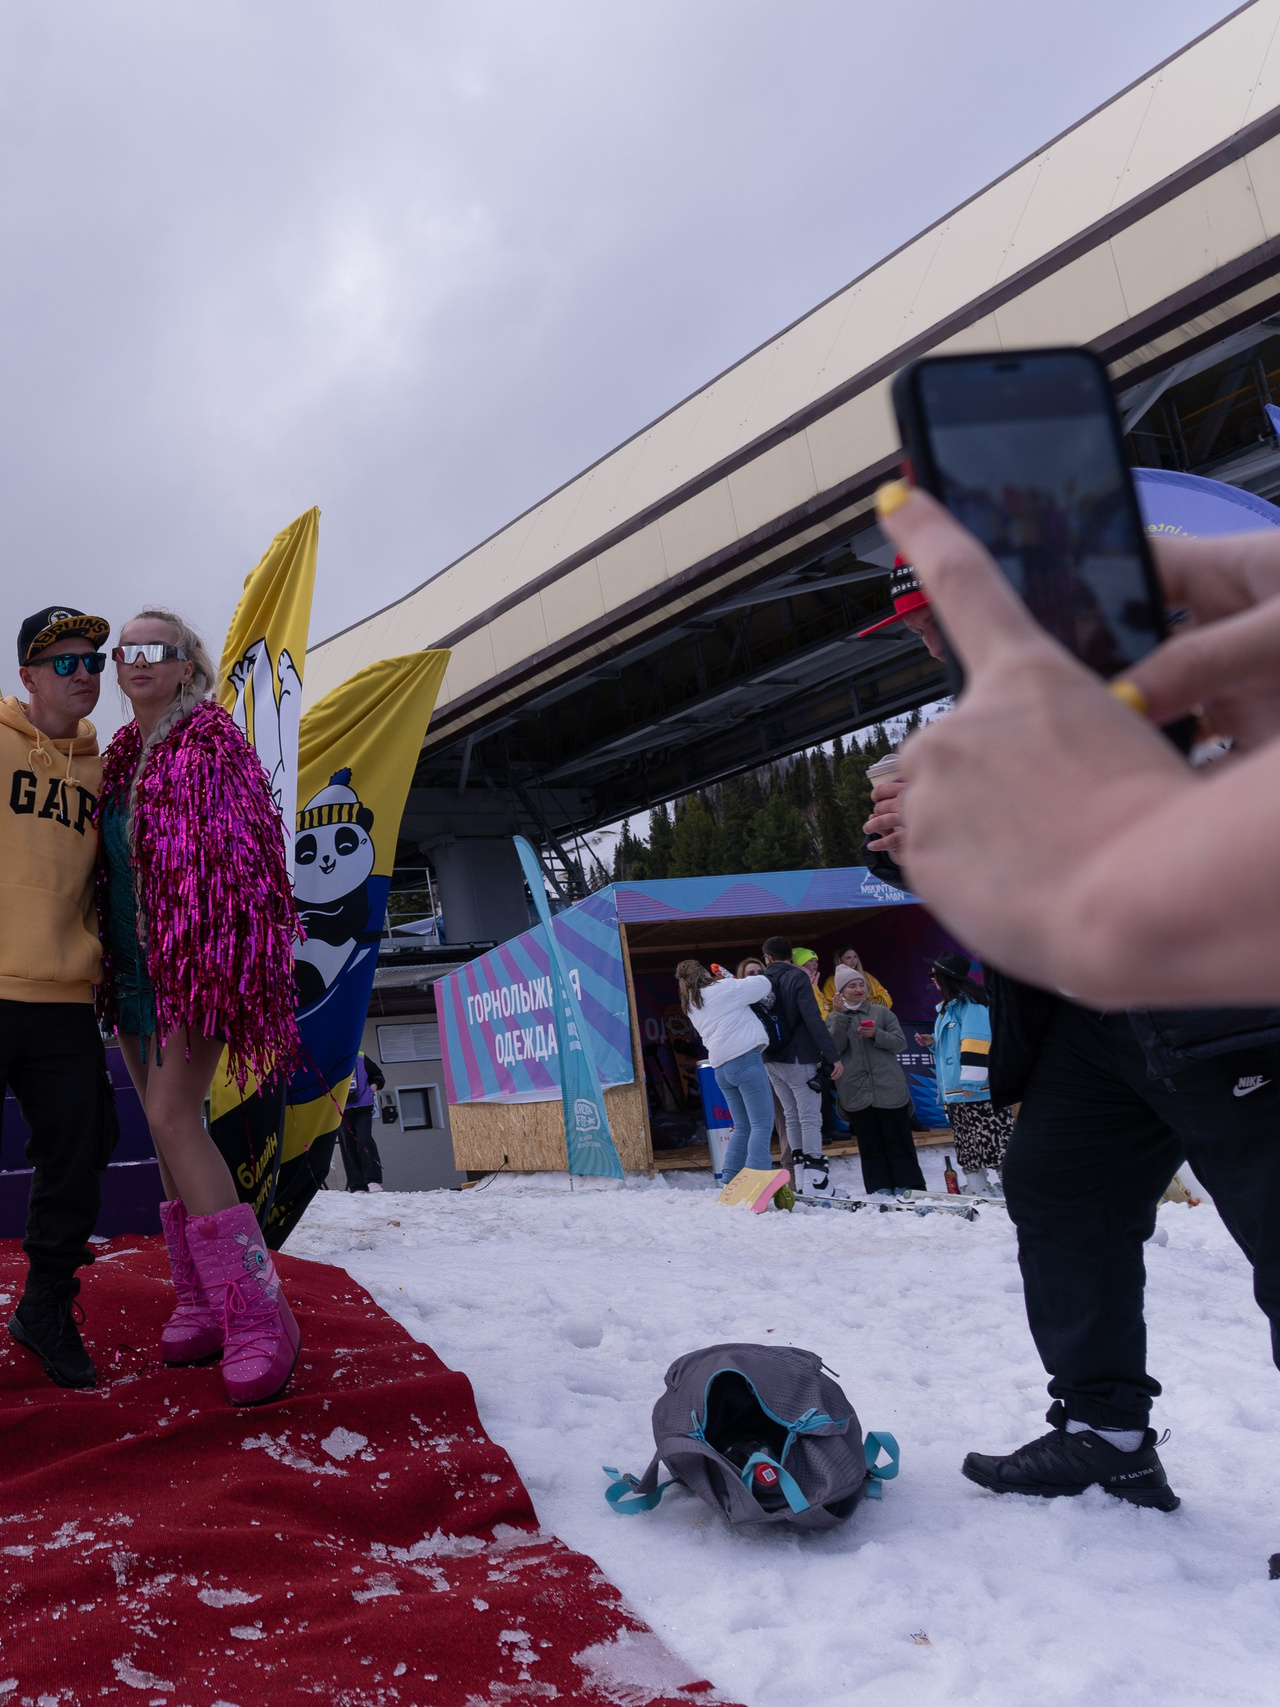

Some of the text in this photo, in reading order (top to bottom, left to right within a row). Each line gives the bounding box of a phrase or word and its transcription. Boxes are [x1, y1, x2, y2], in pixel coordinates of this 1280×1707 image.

[897, 566, 916, 576] ДВИ
[9, 769, 98, 836] GAP
[885, 889, 905, 901] MAN
[467, 968, 582, 1025] ГОРНОЛЫЖЯ
[495, 1023, 559, 1067] ОДЕЖДА
[1238, 1075, 1263, 1088] NIKE
[713, 1105, 732, 1120] Re
[1128, 1468, 1154, 1479] ULTRA
